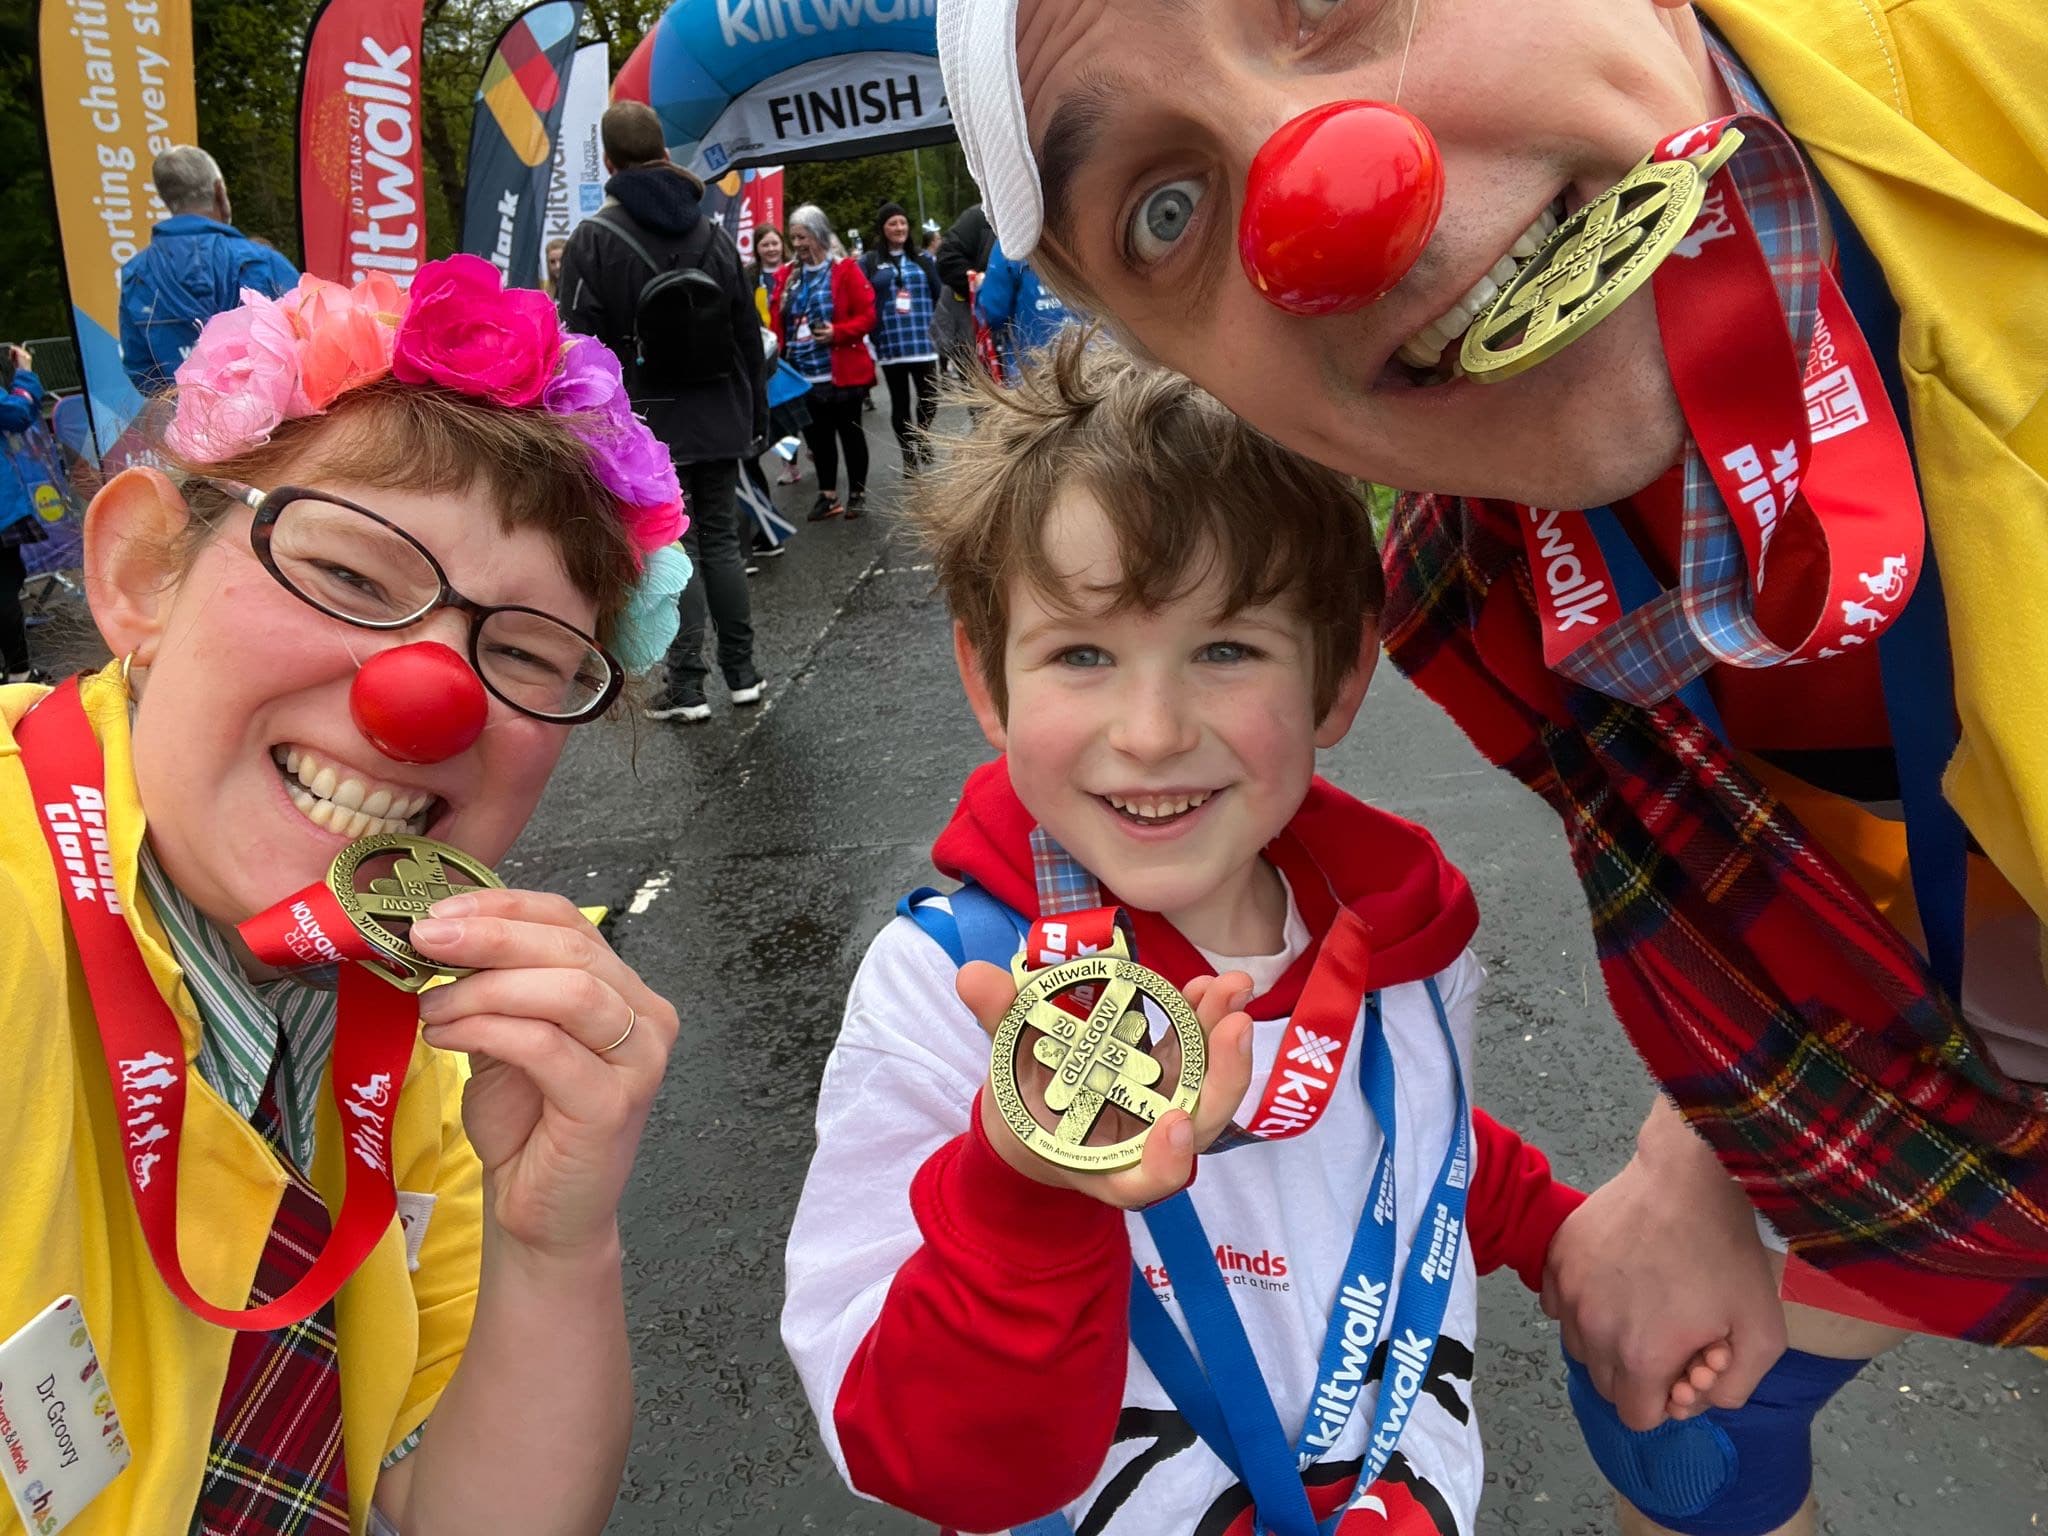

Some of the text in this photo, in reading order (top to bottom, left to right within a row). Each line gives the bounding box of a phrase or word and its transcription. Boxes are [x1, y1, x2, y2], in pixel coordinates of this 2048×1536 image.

[348, 102, 361, 127] OF
[768, 74, 922, 139] FINISH
[350, 133, 364, 194] YEARS
[94, 144, 138, 291] orting
[44, 802, 98, 903] Clark
[1038, 960, 1108, 993] kiltwalk
[1052, 1016, 1128, 1067] 20 25
[1061, 998, 1119, 1085] GLASGOW
[1038, 1138, 1055, 1152] 10th
[1054, 1148, 1101, 1164] Anniversary
[1101, 1152, 1119, 1162] with
[1119, 1149, 1135, 1160] The
[1420, 1202, 1449, 1285] Arnold
[1436, 1216, 1460, 1281] Clark
[1233, 1275, 1247, 1286] at
[1249, 1278, 1258, 1288] a
[1259, 1279, 1290, 1292] time
[1305, 1274, 1387, 1448] kiltwalk
[36, 1372, 80, 1469] Dr Groovy
